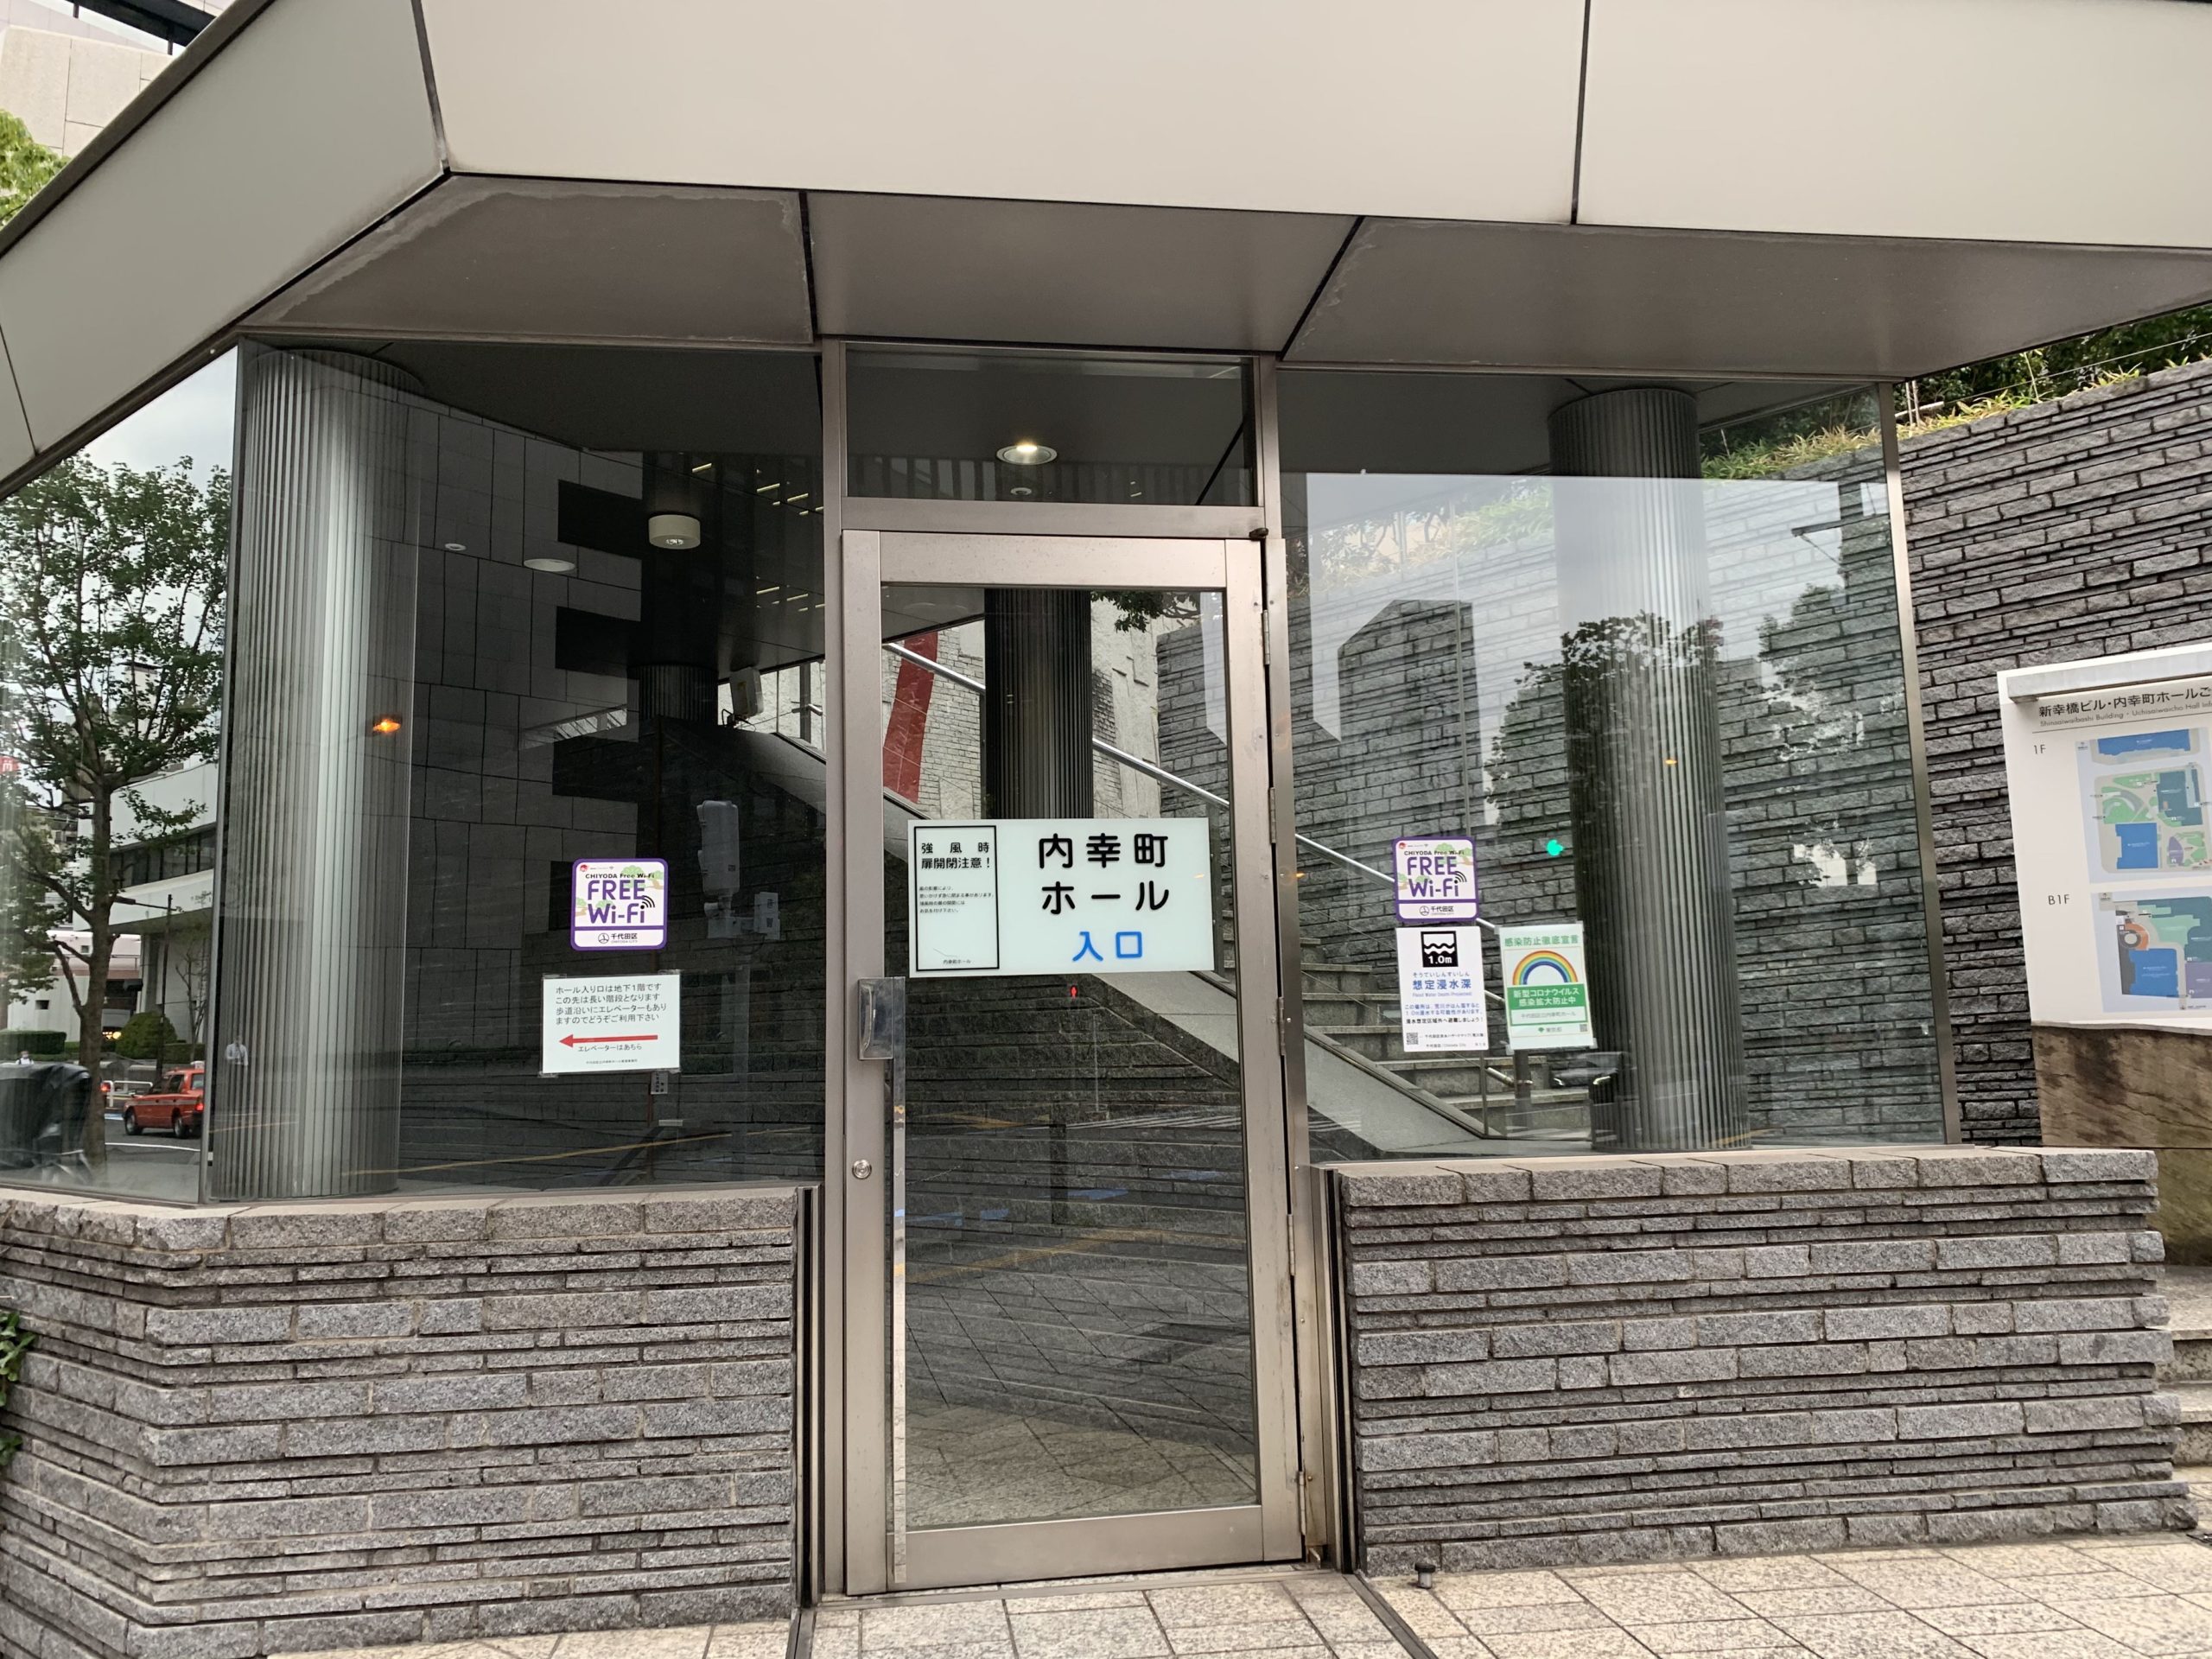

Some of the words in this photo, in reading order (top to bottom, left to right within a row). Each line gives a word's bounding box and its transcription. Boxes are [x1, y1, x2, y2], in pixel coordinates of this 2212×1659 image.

[2095, 711, 2124, 721] Building
[2132, 705, 2184, 717] Uchisaiwaicho
[2033, 744, 2046, 755] 1F
[921, 842, 989, 854] 強風時
[1038, 832, 1168, 870] 内幸町
[1407, 856, 1458, 875] FREE
[588, 880, 646, 900] FREE
[1408, 878, 1459, 898] Wi-Fi
[1041, 880, 1170, 916] ホール
[2048, 893, 2071, 906] B1F
[588, 903, 645, 924] Wi-Fi
[1071, 931, 1143, 963] 入口
[1427, 955, 1452, 964] 1.0m
[555, 982, 662, 995] ホール入り口は地下1階です
[1412, 979, 1472, 990] 想定浸水深
[555, 993, 660, 1005] この先は長い階段となります
[1513, 988, 1580, 998] 新型コロナウイルス
[1518, 996, 1577, 1007] 感染拡大防止中
[556, 1003, 667, 1016] 歩道沿いにエレベーターもあり
[555, 1014, 659, 1026] ますのでどうぞご利用下さい
[577, 1043, 643, 1052] エレベーターはあちら
